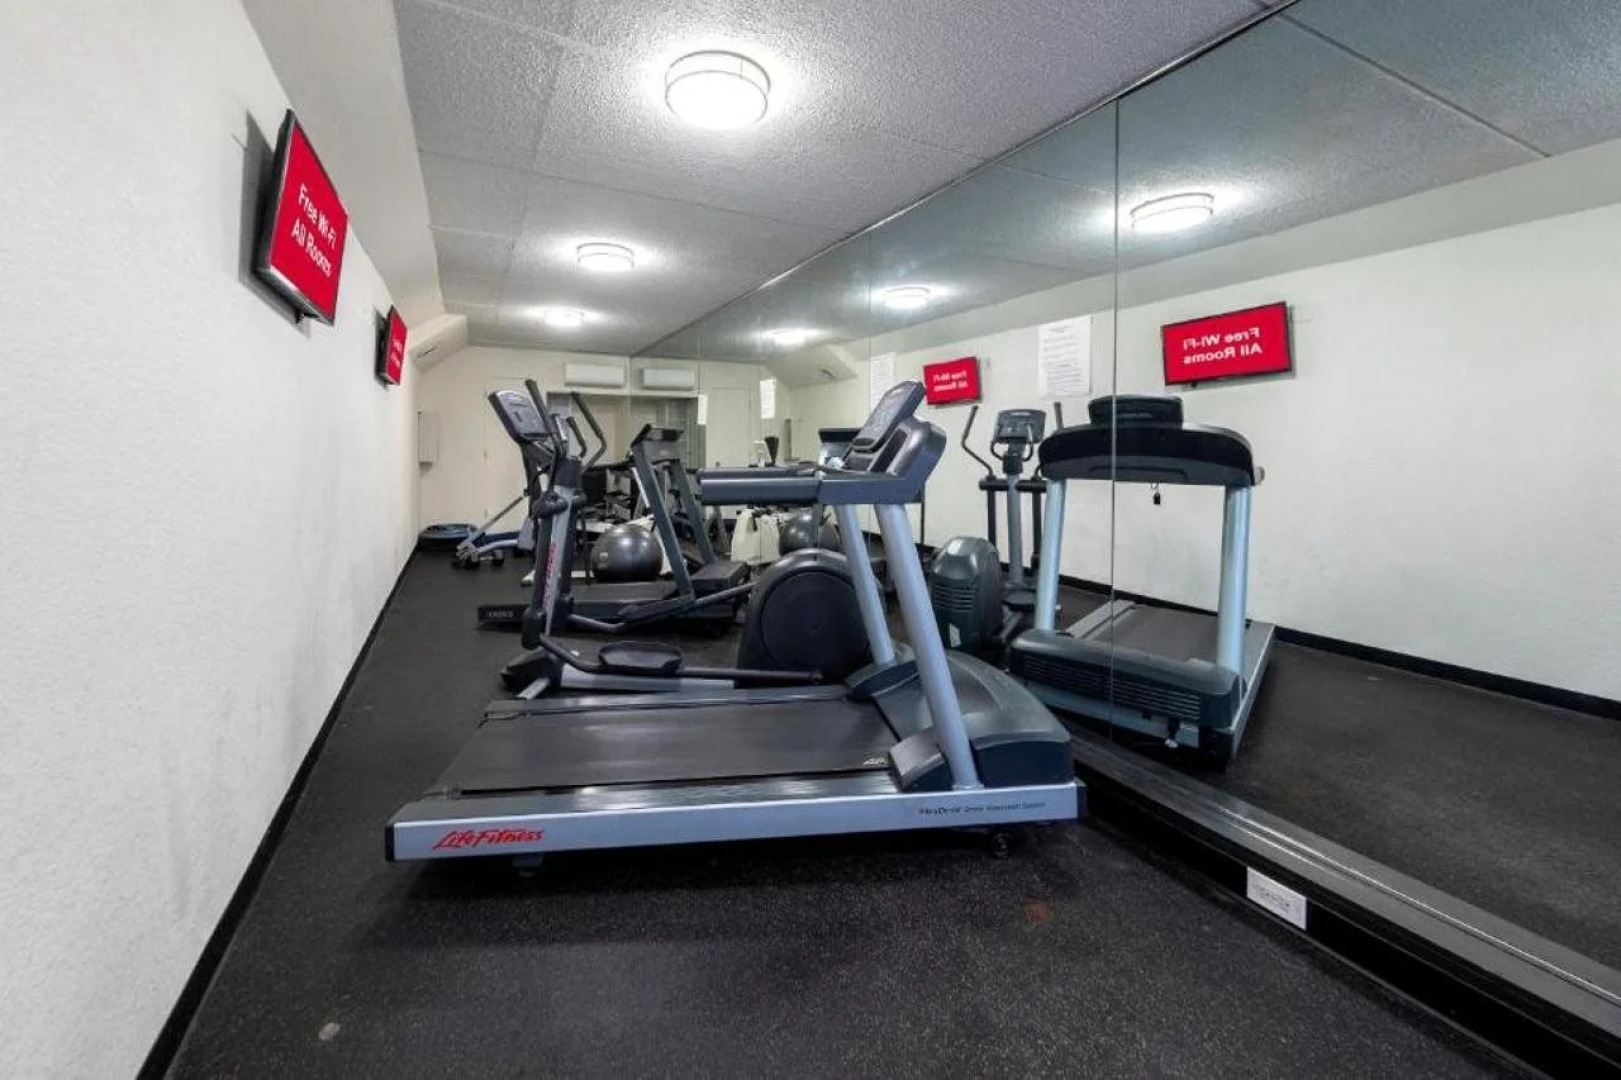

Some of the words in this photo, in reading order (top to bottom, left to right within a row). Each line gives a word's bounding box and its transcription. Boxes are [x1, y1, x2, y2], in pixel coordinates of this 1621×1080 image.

[298, 183, 318, 225] Free
[291, 217, 306, 248] All
[305, 232, 331, 278] Rooms
